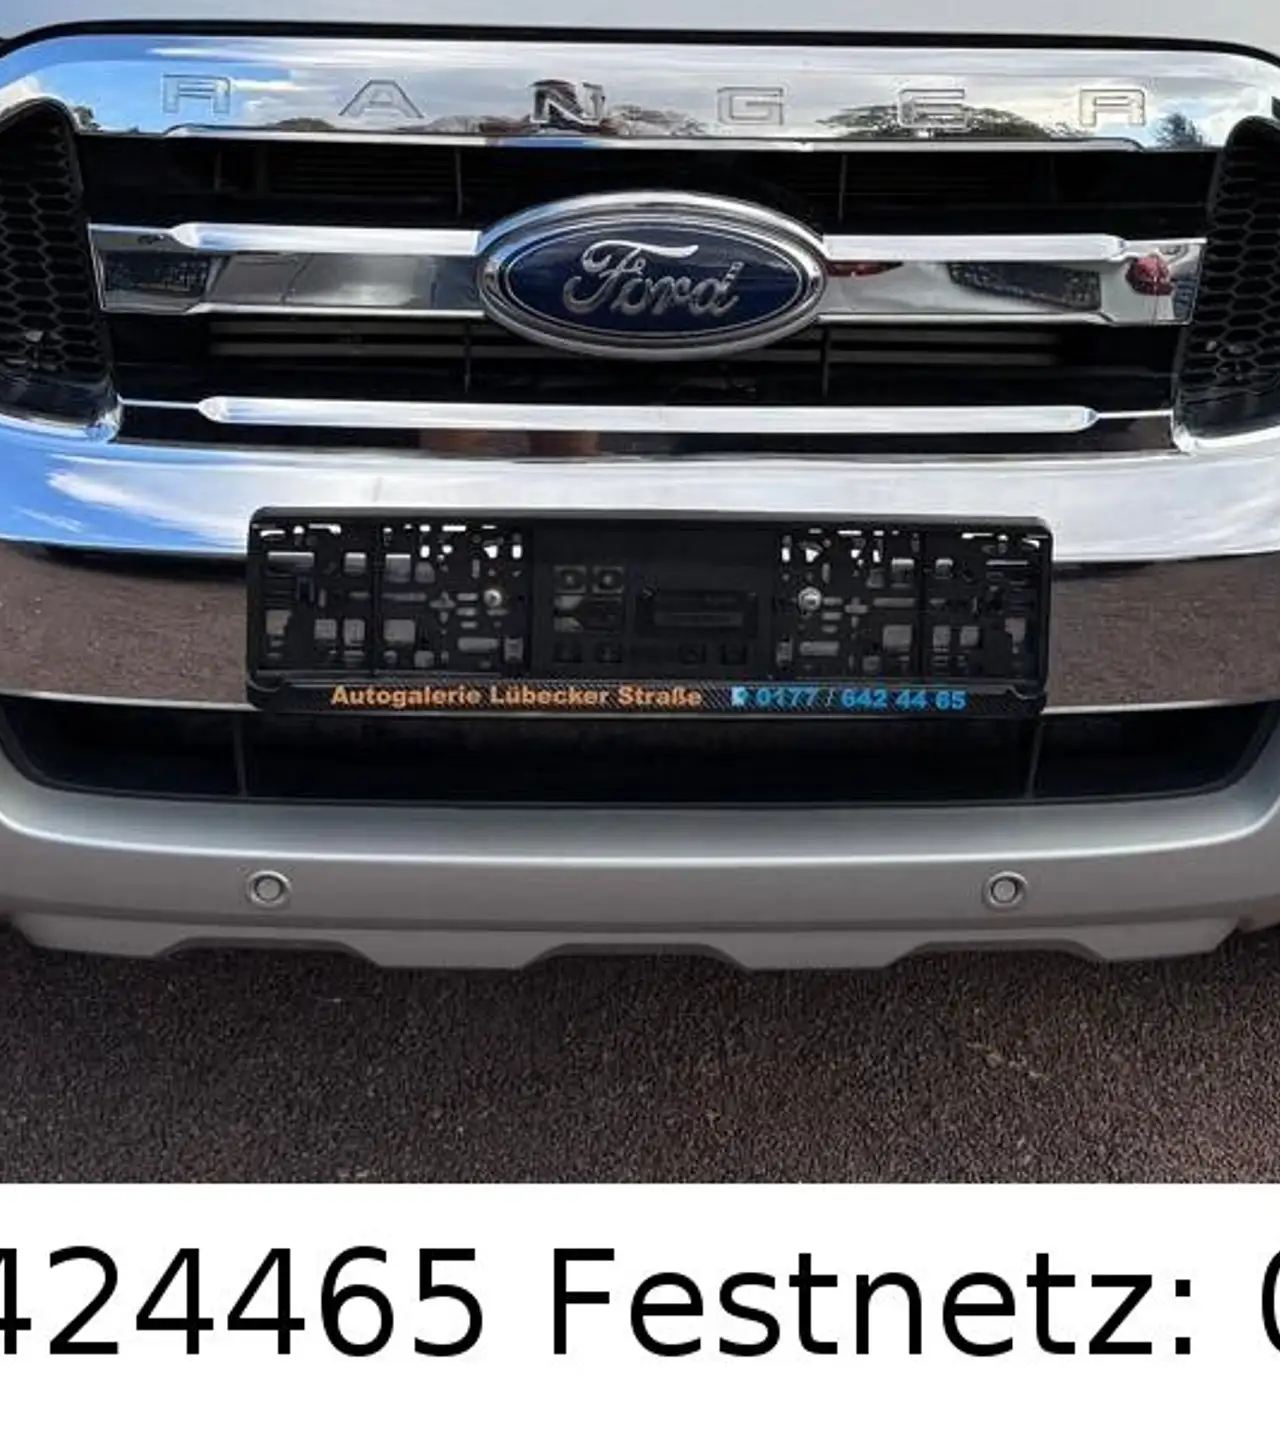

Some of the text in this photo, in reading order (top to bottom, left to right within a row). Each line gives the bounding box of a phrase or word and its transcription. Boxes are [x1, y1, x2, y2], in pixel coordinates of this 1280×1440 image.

[162, 73, 1149, 128] RANGER
[563, 240, 745, 316] Ford
[330, 684, 481, 707] Autogalerie
[489, 684, 609, 706] Lübecker
[618, 685, 703, 707] Straße
[756, 687, 819, 707] 0177
[841, 688, 887, 709] 642
[895, 689, 927, 709] 44
[935, 690, 966, 710] 65
